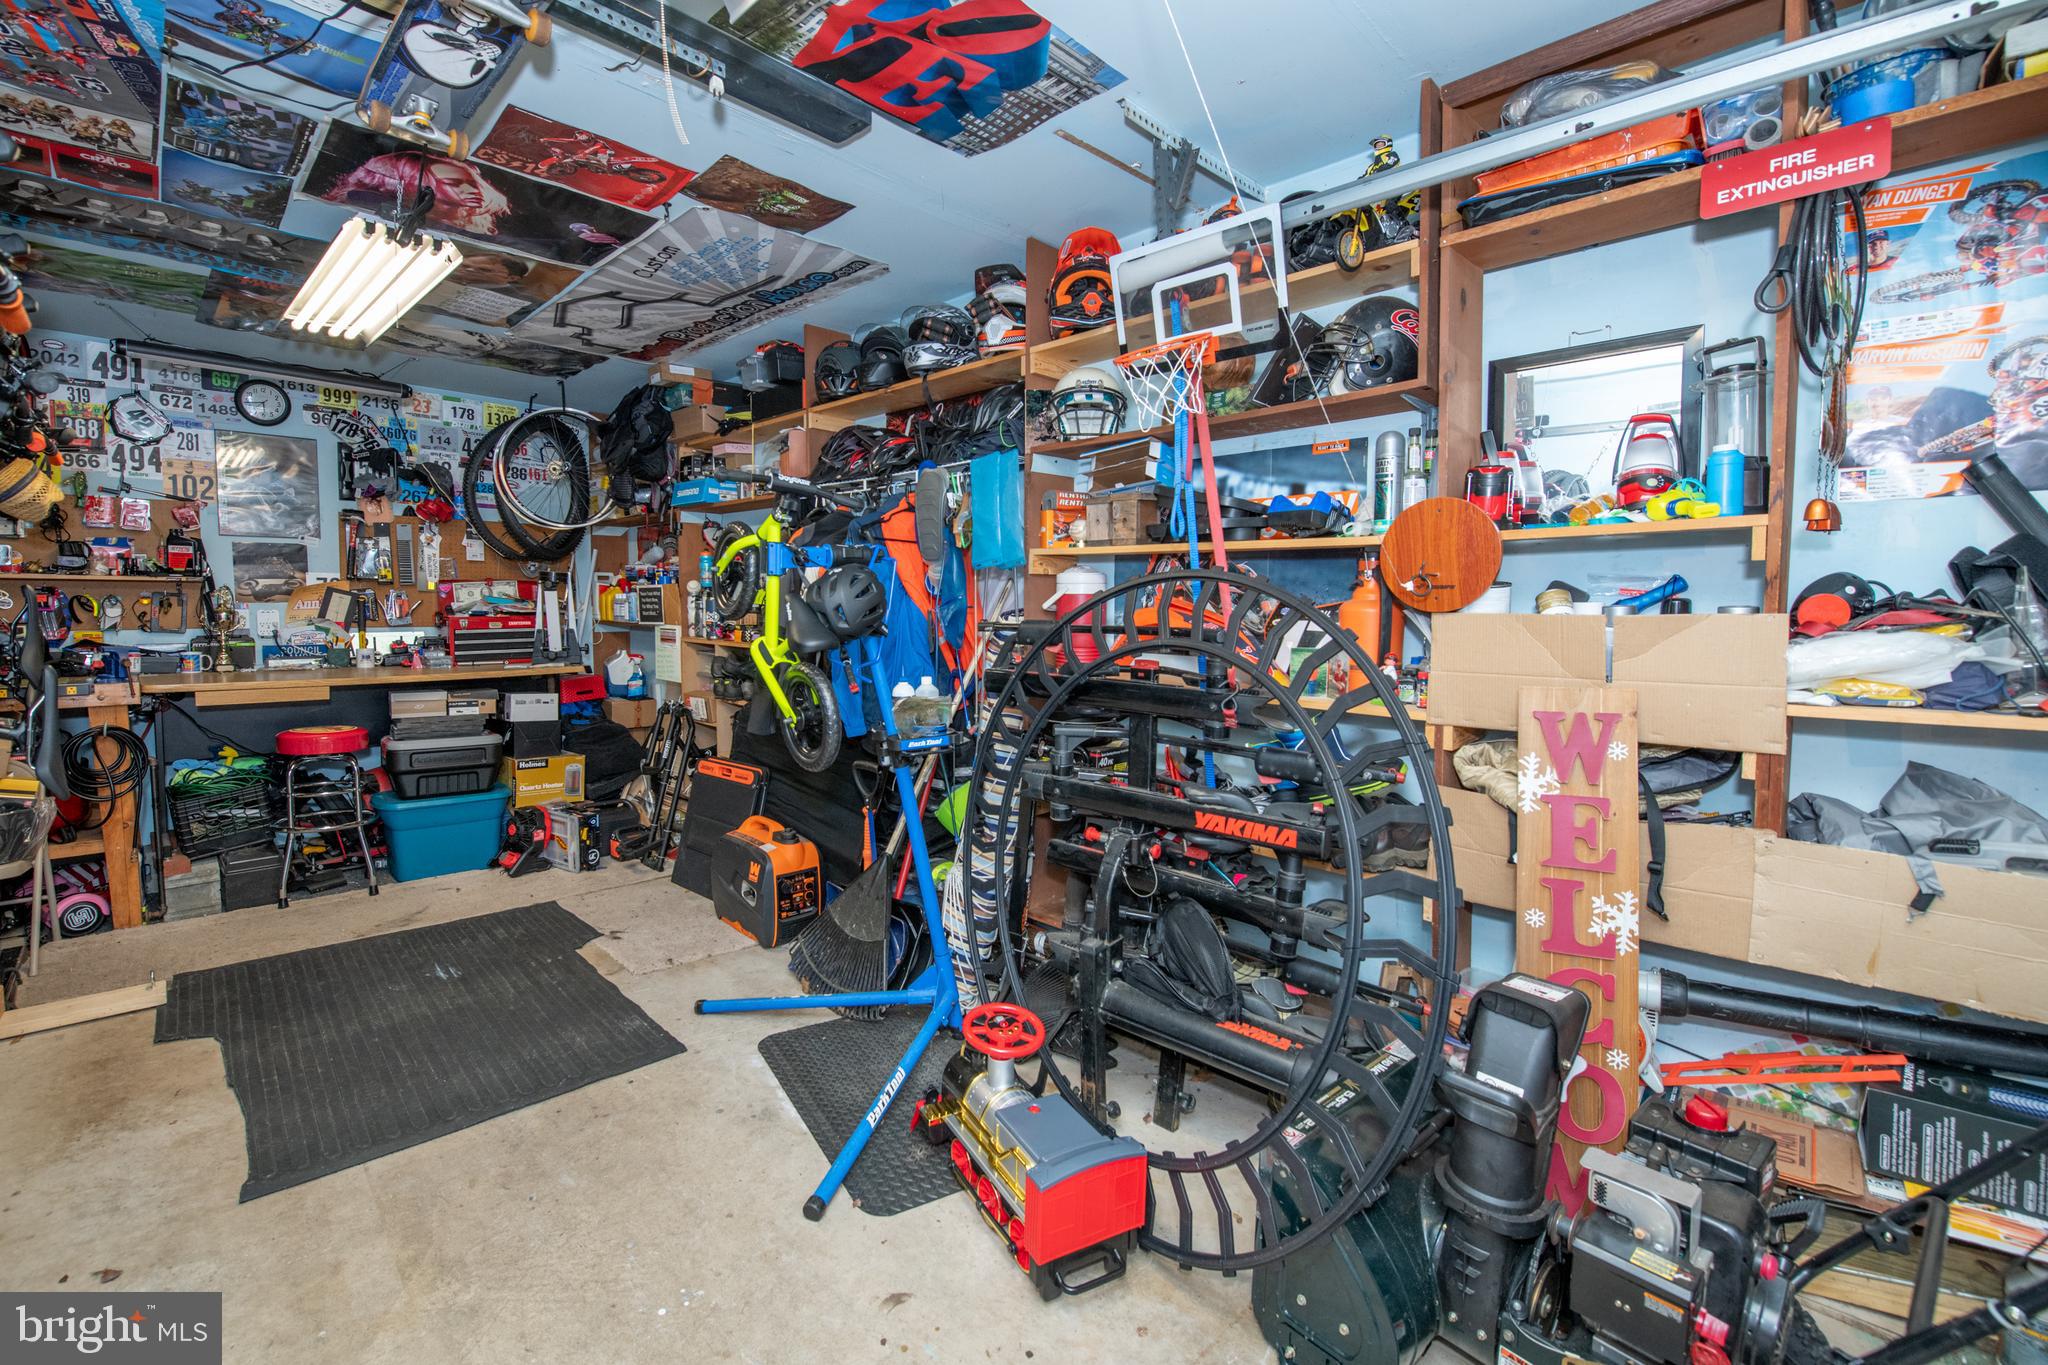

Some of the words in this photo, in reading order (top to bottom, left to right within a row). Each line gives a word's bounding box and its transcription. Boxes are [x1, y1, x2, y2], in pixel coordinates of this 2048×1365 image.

[1769, 148, 1818, 173] FIRE
[1717, 153, 1876, 206] EXTINGUISHER
[1893, 181, 1961, 205] DUNGEY
[633, 245, 681, 279] Custom
[31, 349, 80, 368] 2042
[92, 351, 146, 384] 491
[158, 368, 202, 383] 4106
[211, 371, 241, 389] 697
[279, 379, 317, 394] 1613
[67, 386, 91, 403] 319
[159, 393, 194, 410] 672
[323, 387, 353, 404] 999
[197, 402, 239, 417] 1489
[413, 399, 432, 414] 23
[450, 406, 475, 420] 178
[177, 431, 200, 451] 281
[428, 435, 451, 446] 114
[63, 453, 100, 468] 966
[112, 443, 162, 473] 494
[168, 474, 215, 500] 102
[519, 761, 547, 769] Holmes
[520, 783, 541, 791] Quartz
[543, 782, 564, 790] Heater
[1195, 811, 1299, 849] YAKIMA
